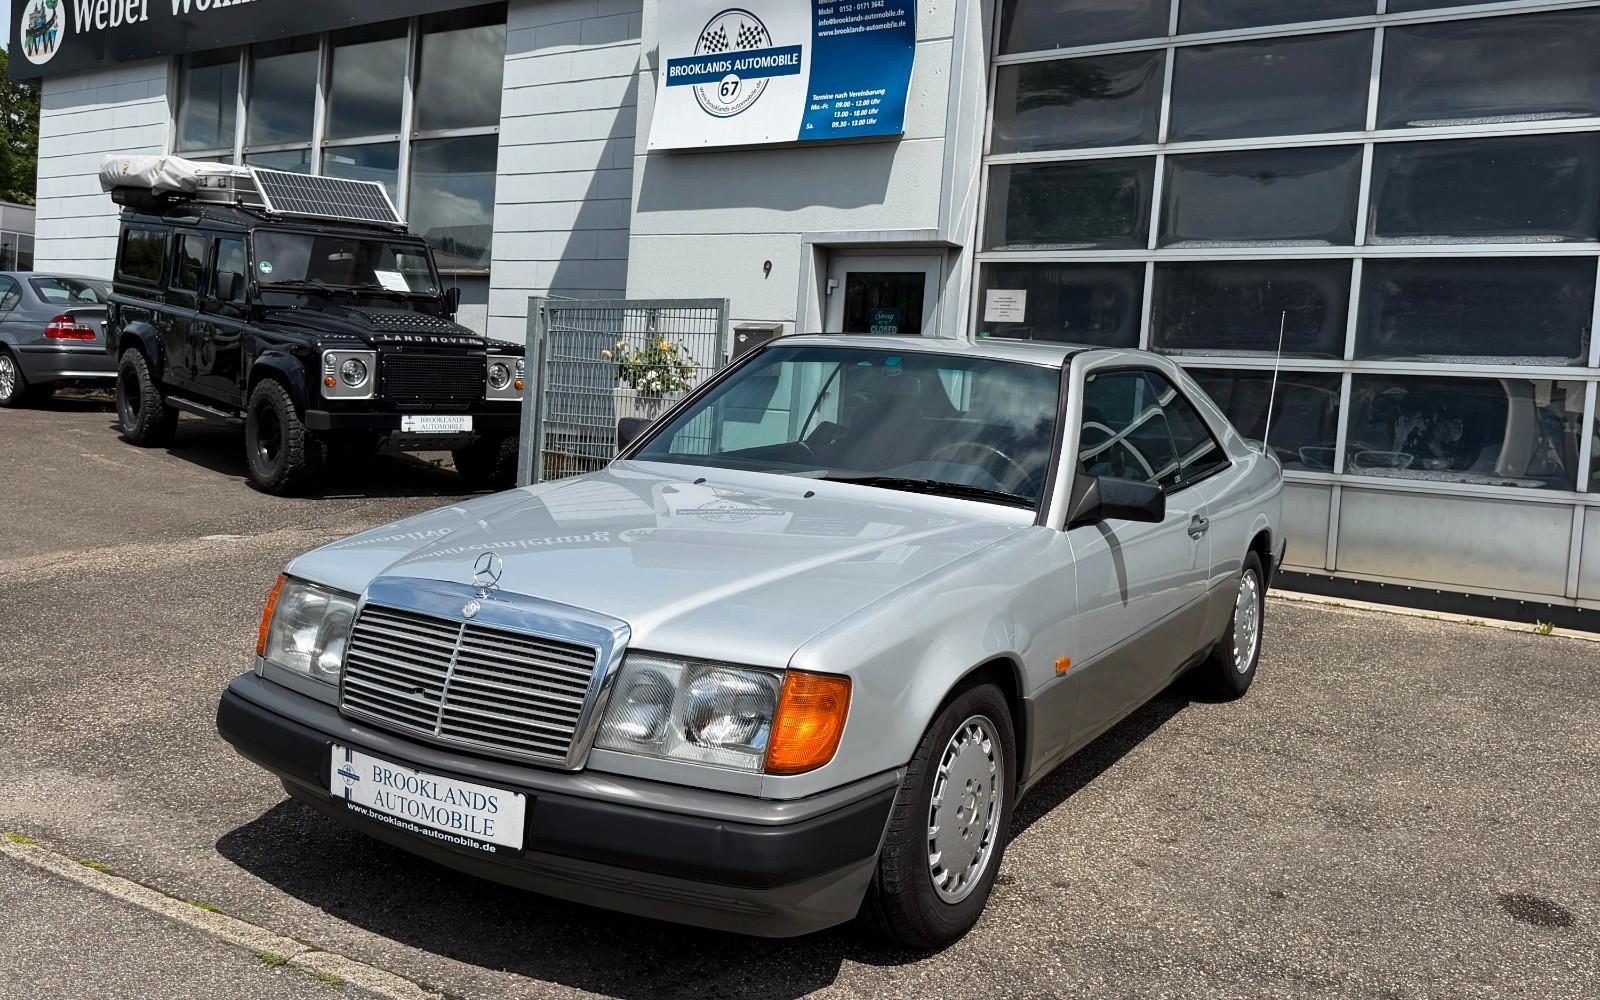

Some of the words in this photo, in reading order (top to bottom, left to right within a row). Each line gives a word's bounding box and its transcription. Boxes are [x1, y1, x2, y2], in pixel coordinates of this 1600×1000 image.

[74, 0, 149, 34] Weber
[818, 7, 834, 16] Mobil
[839, 4, 853, 13] 0152
[818, 9, 905, 27] info@brooklands-automobile.de
[818, 20, 907, 37] www.brooklands-automobile.de
[669, 60, 732, 77] BROOKLANDS
[734, 53, 799, 71] AUTOMOBILE
[720, 81, 740, 97] 67
[813, 93, 834, 101] Termine
[835, 91, 848, 99] nach
[849, 88, 886, 98] Vereinbarung
[763, 259, 773, 280] 9
[870, 325, 898, 334] CLOSED
[383, 334, 423, 342] LAND
[430, 336, 481, 345] ROVER
[372, 764, 498, 814] BROOKLANDS
[374, 789, 495, 837] AUTOMOBILE
[347, 802, 496, 853] www.brooklands-automobile.de
